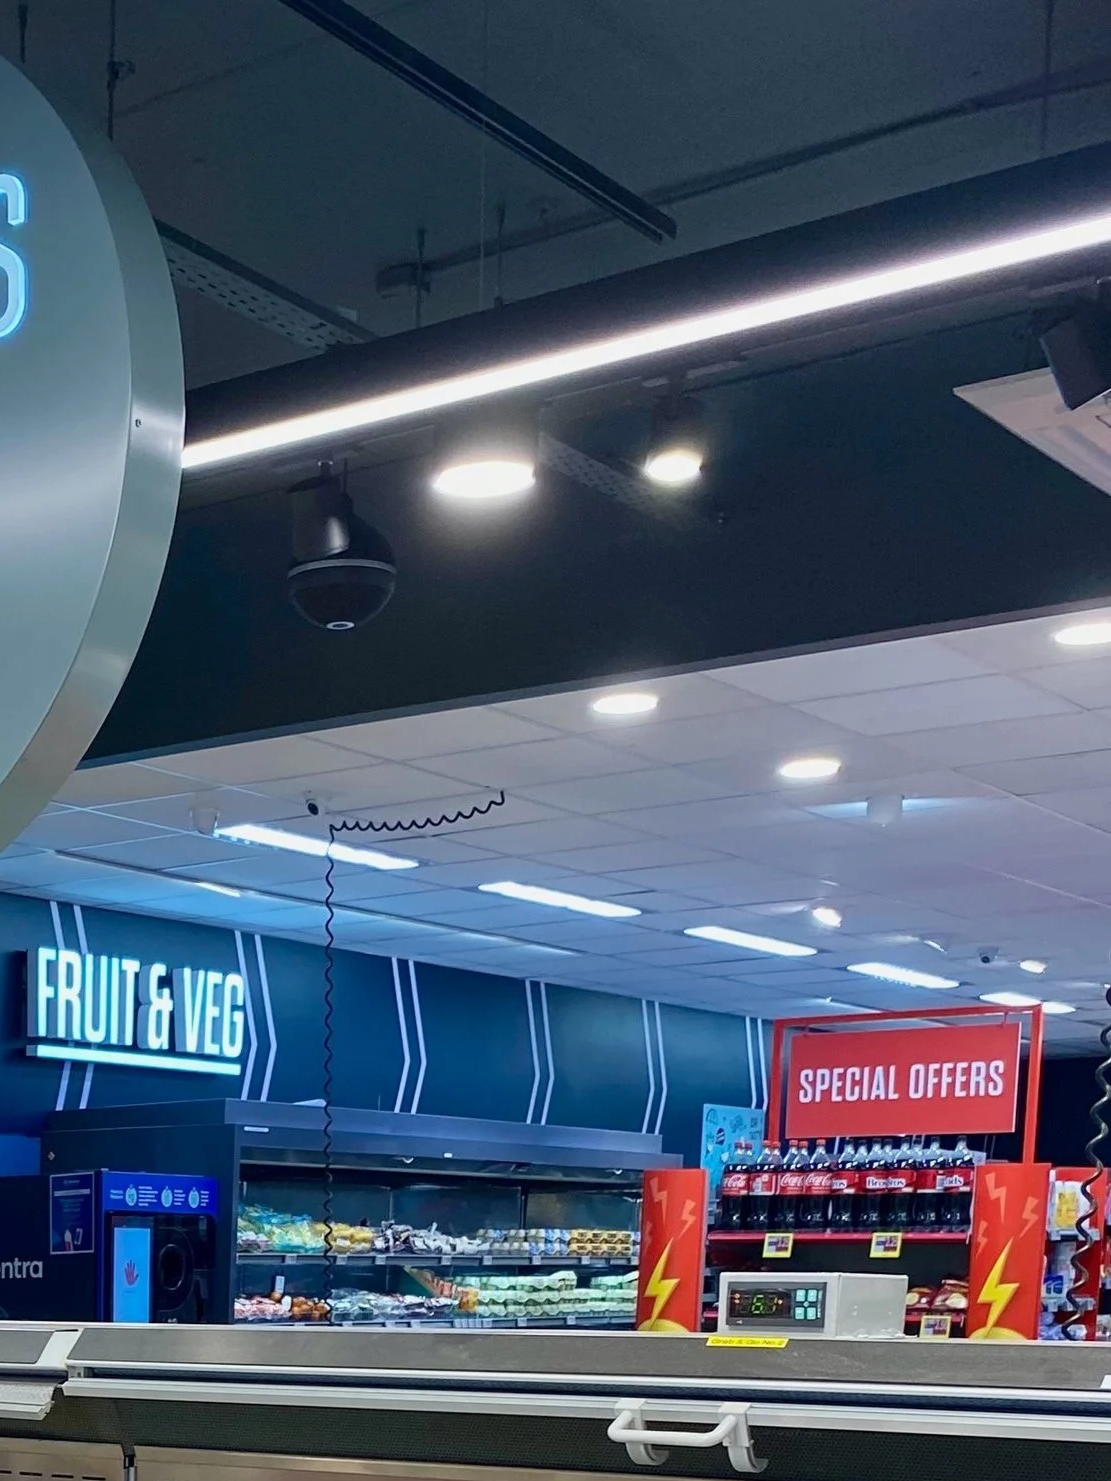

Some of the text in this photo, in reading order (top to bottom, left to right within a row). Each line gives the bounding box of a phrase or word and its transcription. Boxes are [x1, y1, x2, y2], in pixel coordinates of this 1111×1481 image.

[36, 946, 244, 1060] FRUIT & VEG
[798, 1060, 1006, 1104] SPECIAL OFFERS
